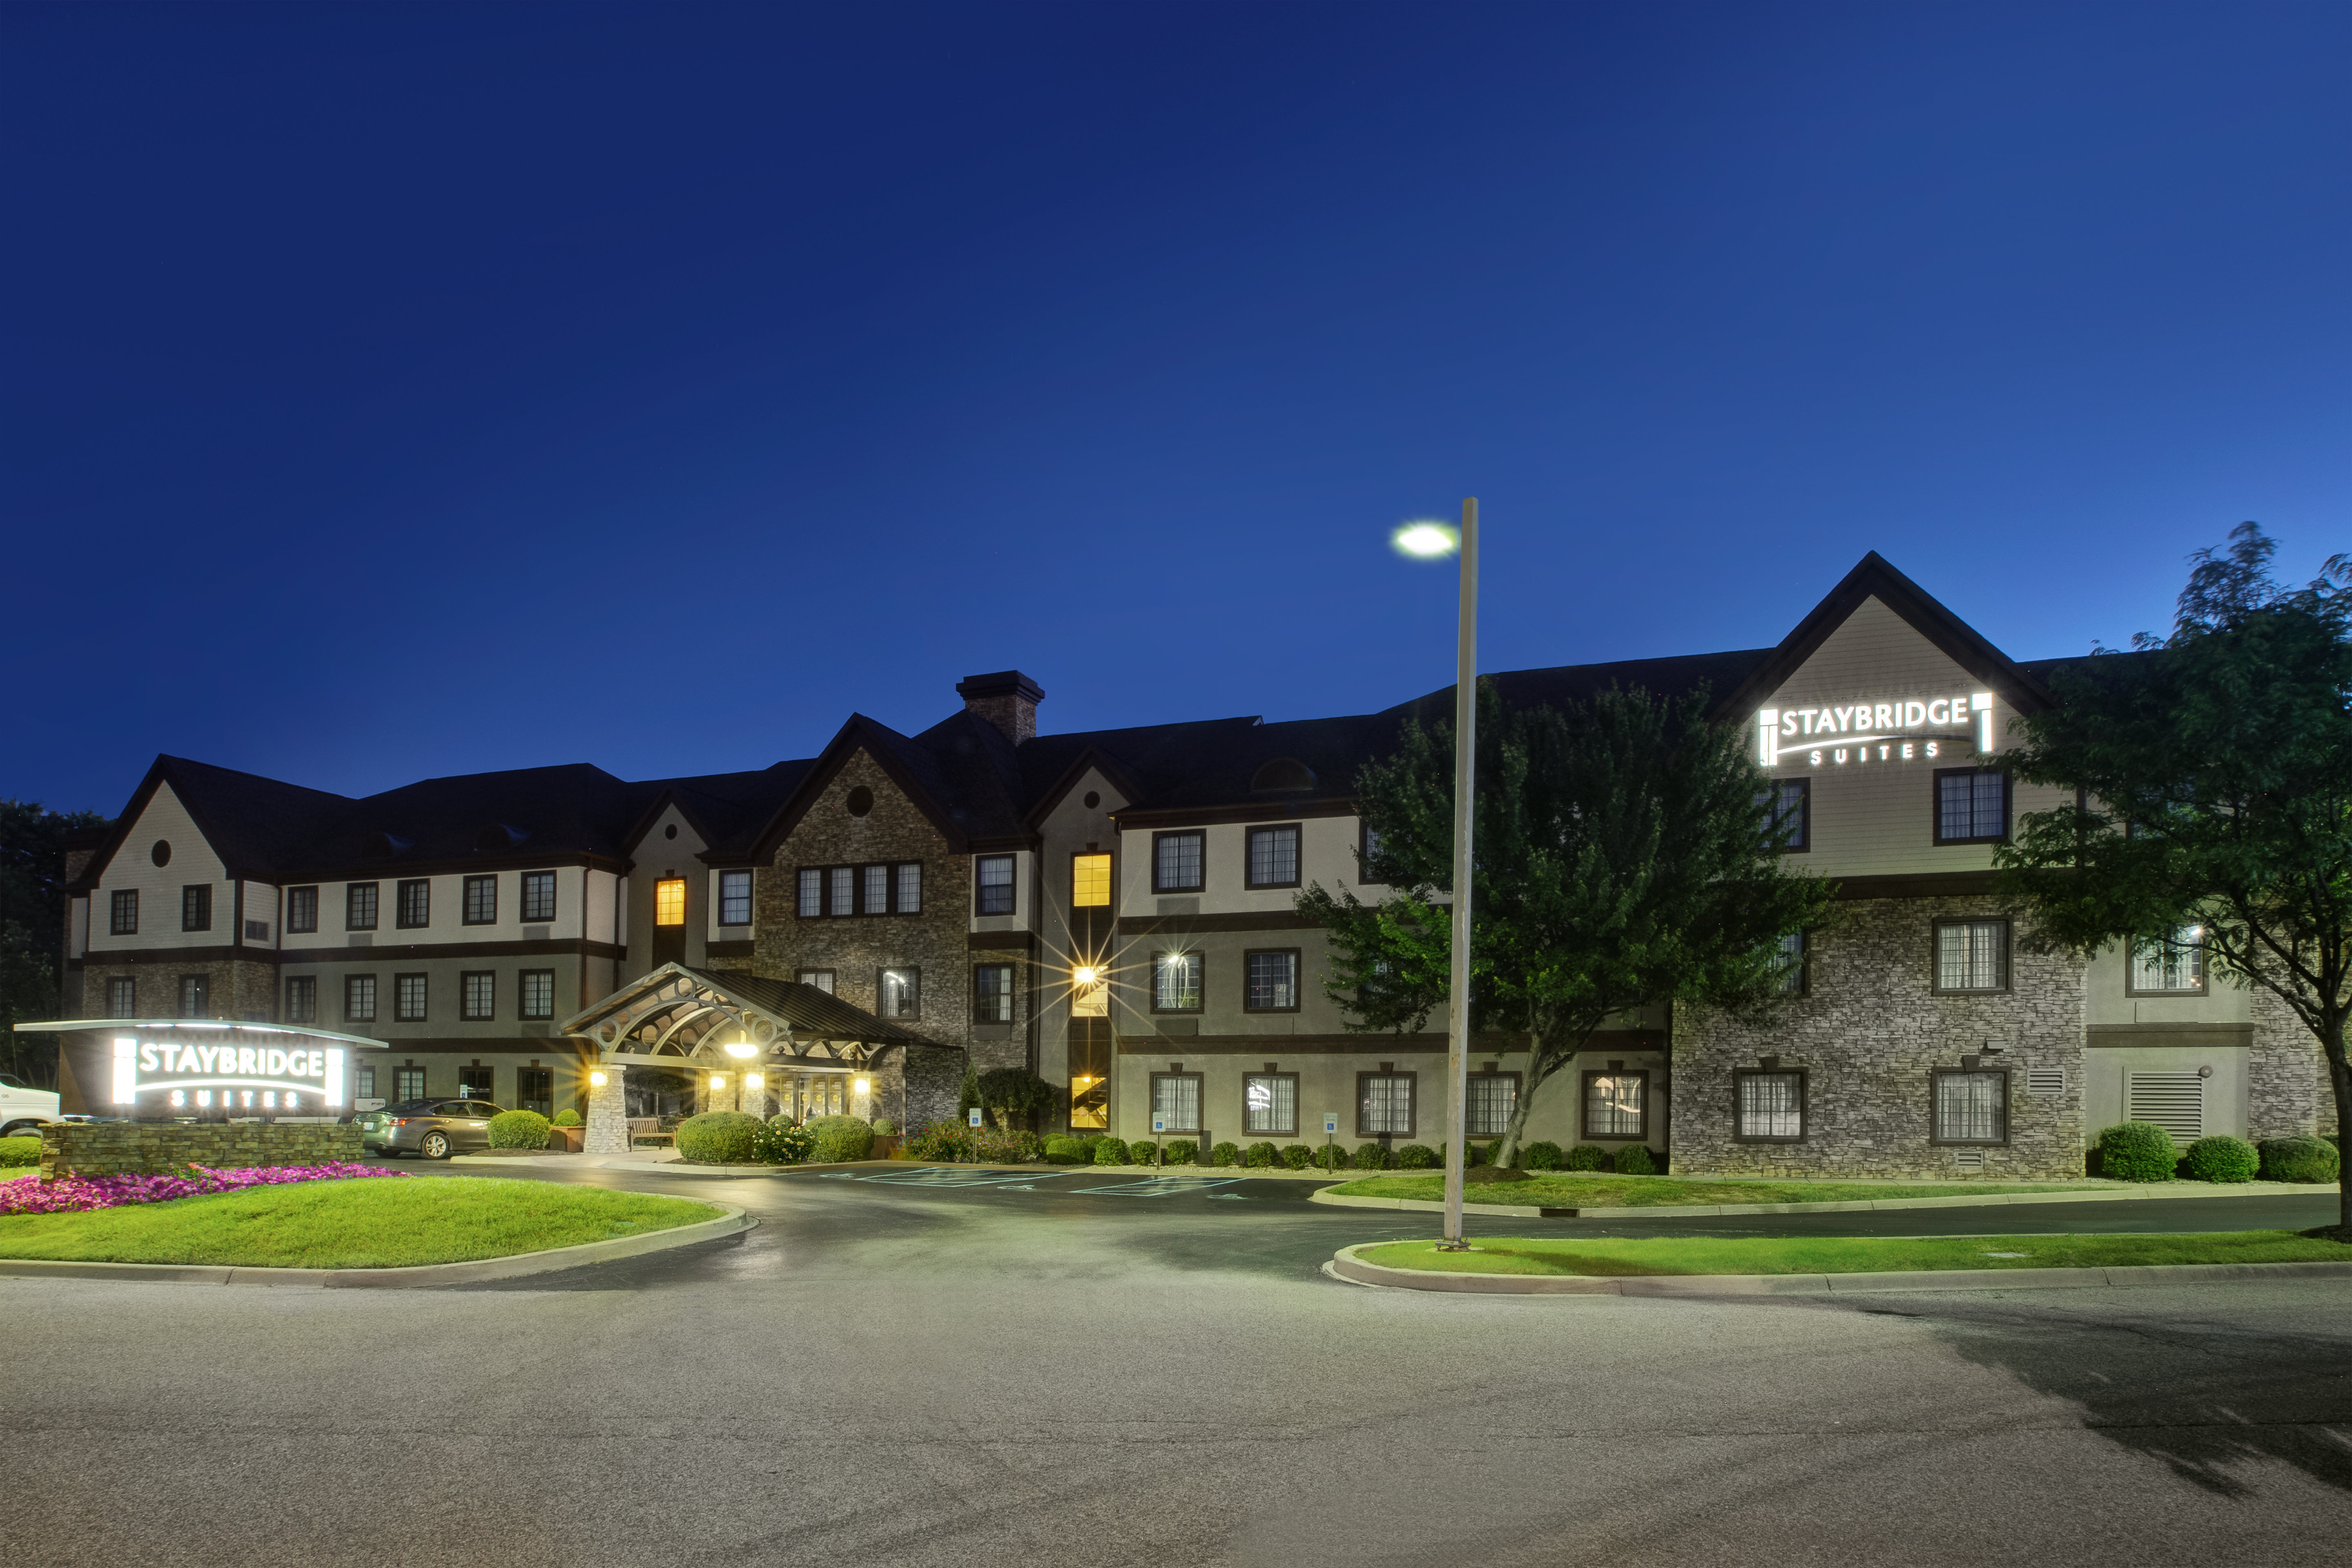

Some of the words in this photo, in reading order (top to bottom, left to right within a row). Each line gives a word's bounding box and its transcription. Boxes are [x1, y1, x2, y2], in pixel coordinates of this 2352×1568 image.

[1781, 698, 1968, 735] STAYBRIDGE
[1811, 742, 1938, 764] SUITES
[139, 1042, 324, 1077] STAYBRIDGE
[171, 1089, 298, 1108] SUITES
